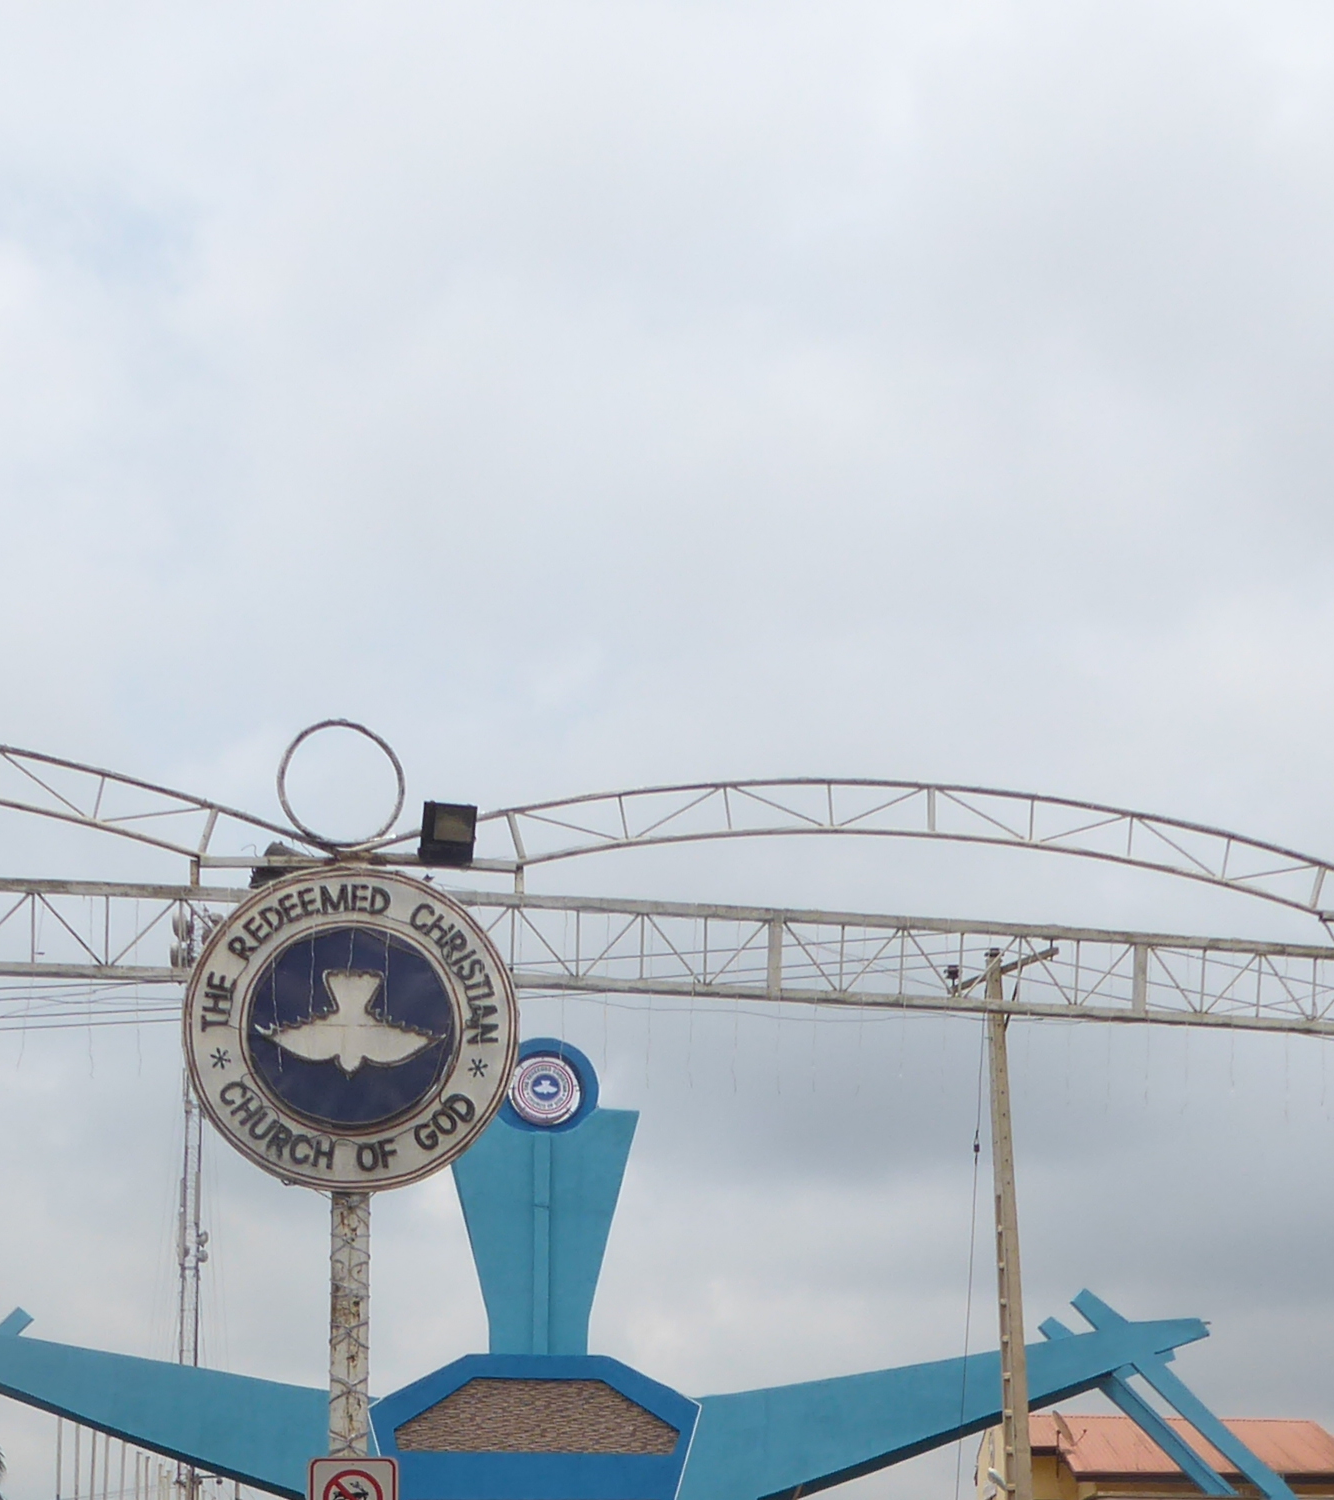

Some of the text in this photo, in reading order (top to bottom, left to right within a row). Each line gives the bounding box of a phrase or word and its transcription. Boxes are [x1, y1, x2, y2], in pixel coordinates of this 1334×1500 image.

[201, 884, 499, 1046] THE REDEEMED CHRISTIAN
[220, 1081, 476, 1172] CHURCH OF GOD
